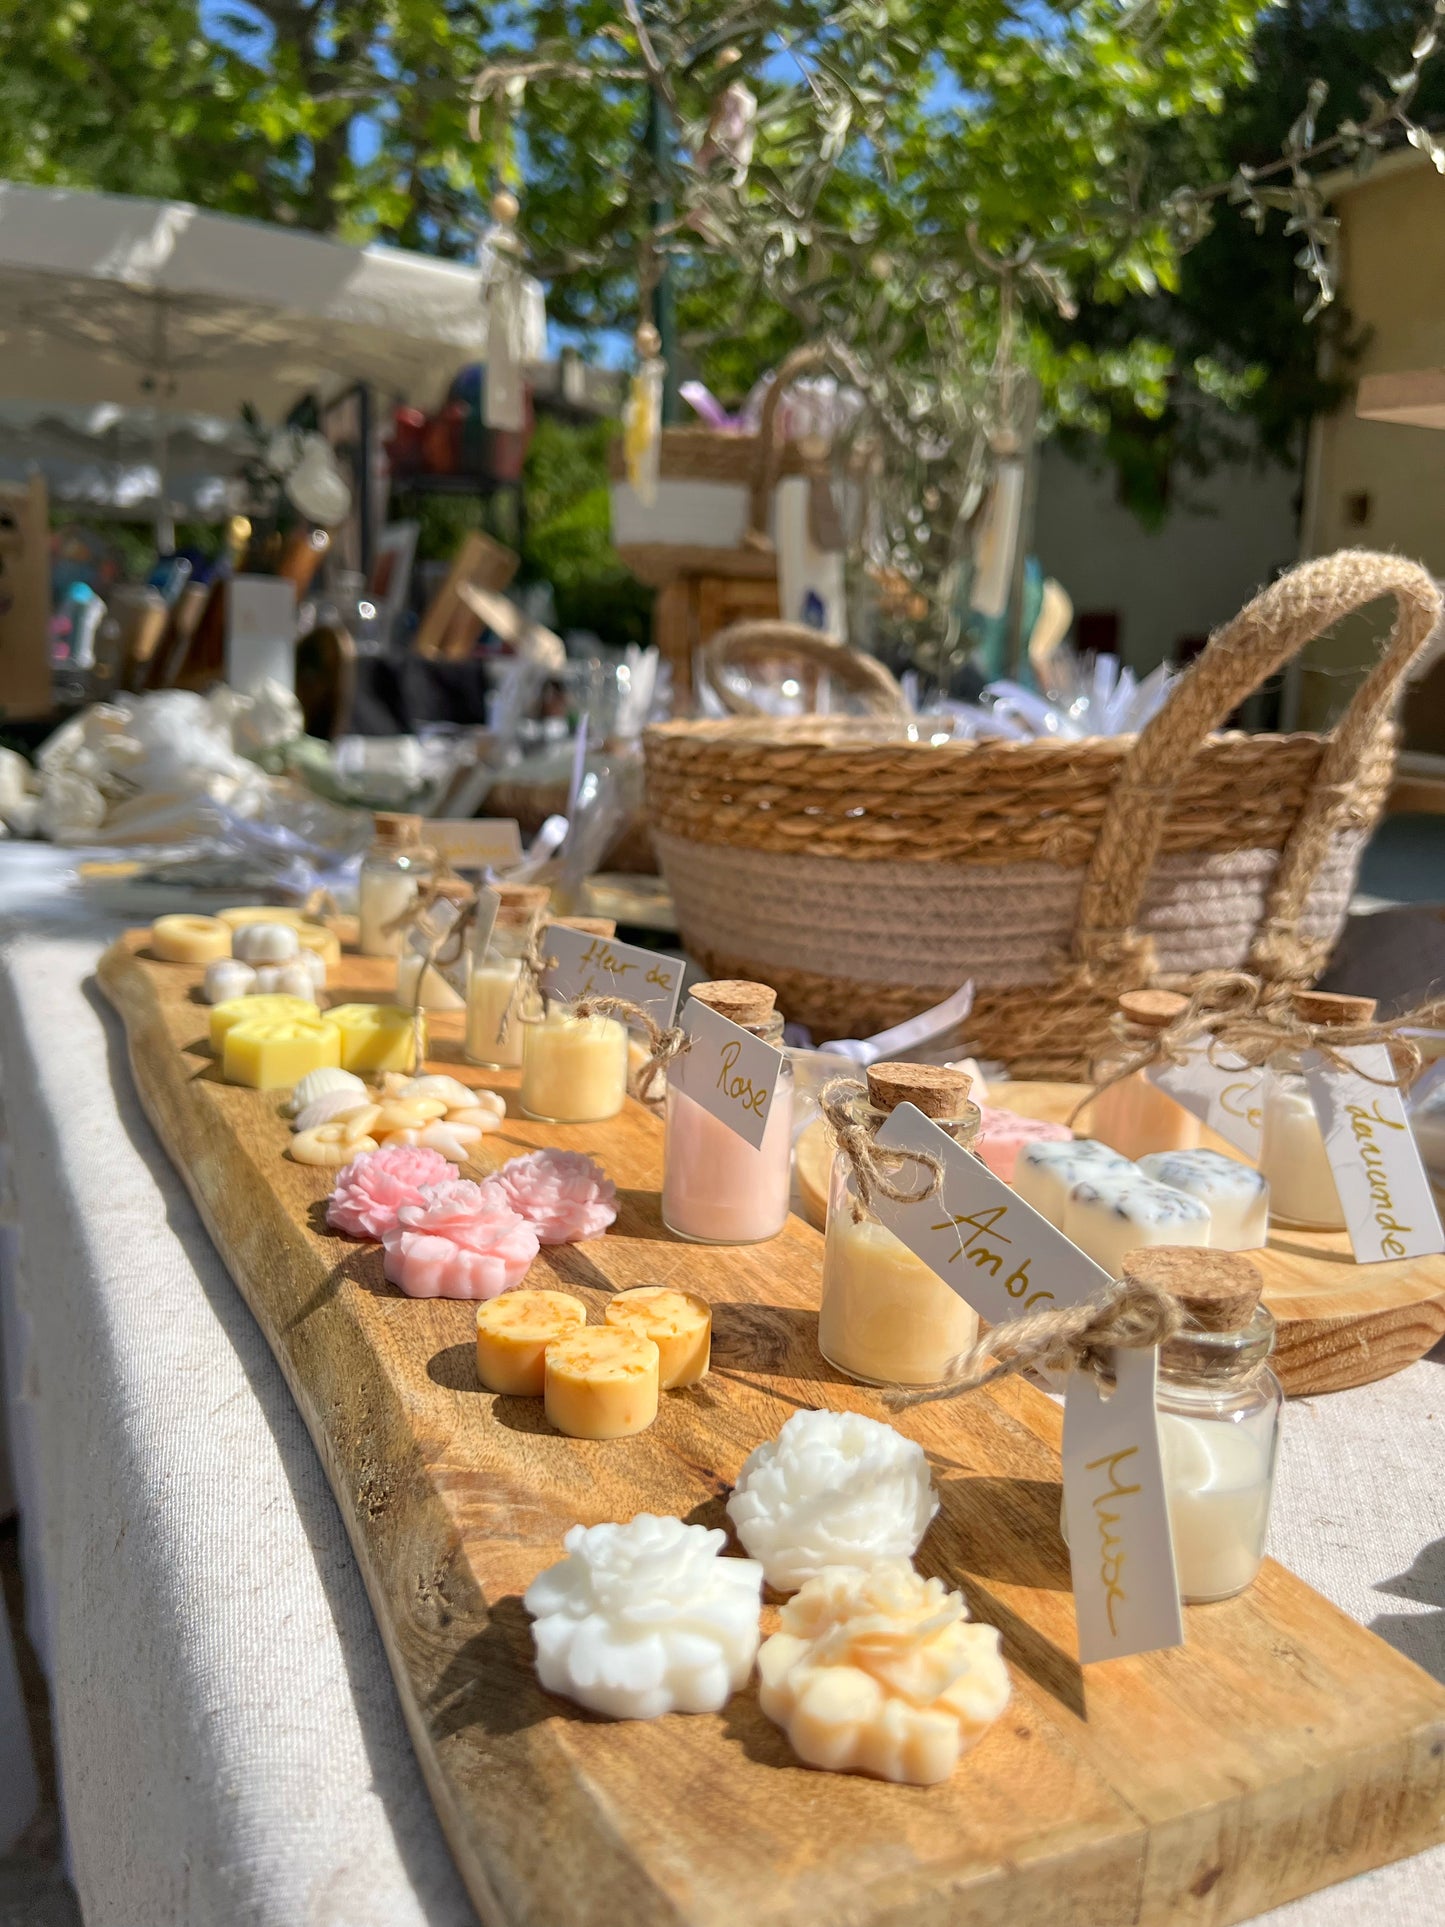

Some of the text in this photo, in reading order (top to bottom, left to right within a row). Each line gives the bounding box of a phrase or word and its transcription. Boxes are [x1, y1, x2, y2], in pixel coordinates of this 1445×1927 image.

[644, 964, 673, 992] de
[716, 1040, 768, 1119] Rose
[1344, 1099, 1413, 1259] Lavande
[930, 1205, 1055, 1311] Ambr
[1084, 1445, 1142, 1638] Musc
